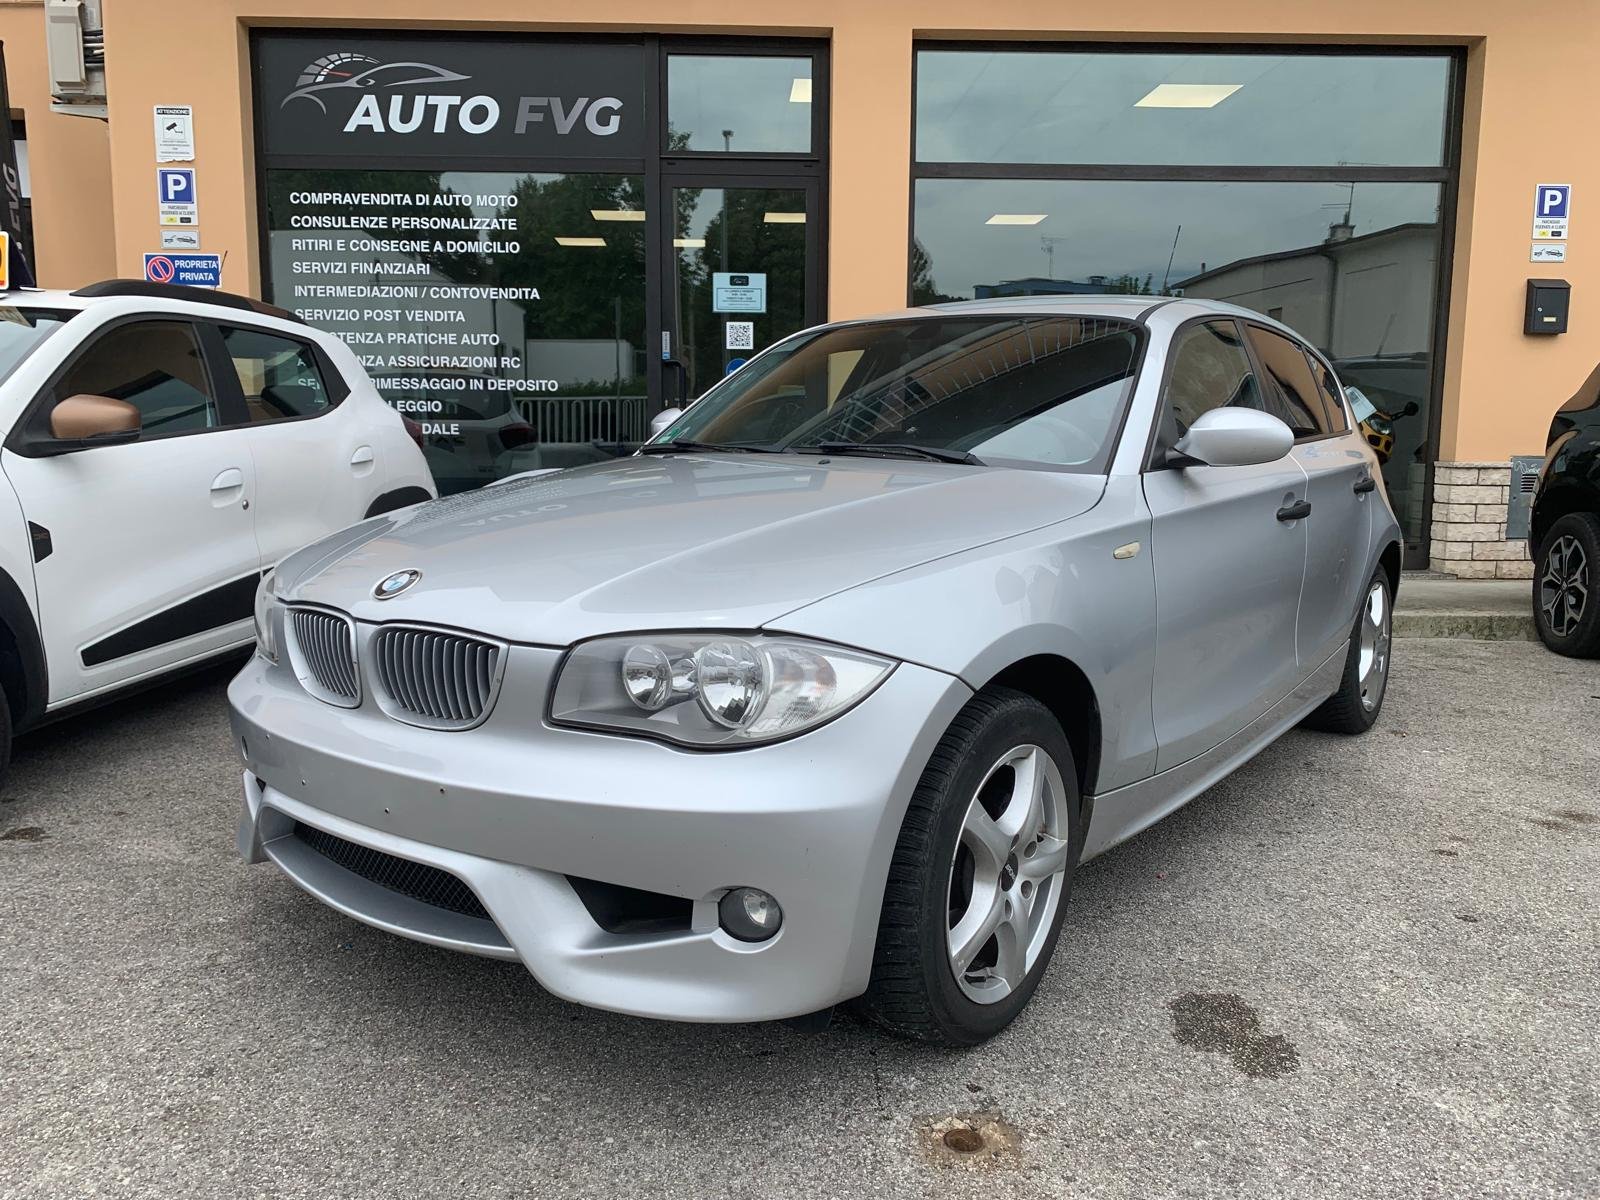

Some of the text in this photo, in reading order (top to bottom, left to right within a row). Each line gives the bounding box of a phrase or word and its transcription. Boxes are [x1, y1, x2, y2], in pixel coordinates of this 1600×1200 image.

[343, 94, 624, 136] AUTO FVG
[167, 173, 187, 199] P
[289, 192, 518, 207] COMPRAVENDITA DI AUTO MOTO
[1543, 189, 1563, 214] P
[290, 215, 517, 230] CONSULENZE PERSONALIZZATE
[292, 239, 520, 253] RITIRI E CONSEGNE A DOMICILIO
[174, 260, 219, 269] PROPRIETA'
[292, 262, 430, 275] SERVIZI FINANZIARI
[180, 272, 215, 281] PRIVATA
[294, 285, 540, 300] INTERMEDIAZIONI / CONTOVENDITA
[295, 308, 466, 322] SERVIZIO POST VENDITA
[329, 331, 500, 346] TENZA PRATICHE AUTO
[387, 355, 497, 368] ASSICURAZIONI
[501, 356, 521, 369] RC
[469, 379, 484, 391] IN
[487, 379, 559, 392] DEPOSITO
[388, 400, 442, 412] EGGIO
[421, 423, 460, 435] DALE
